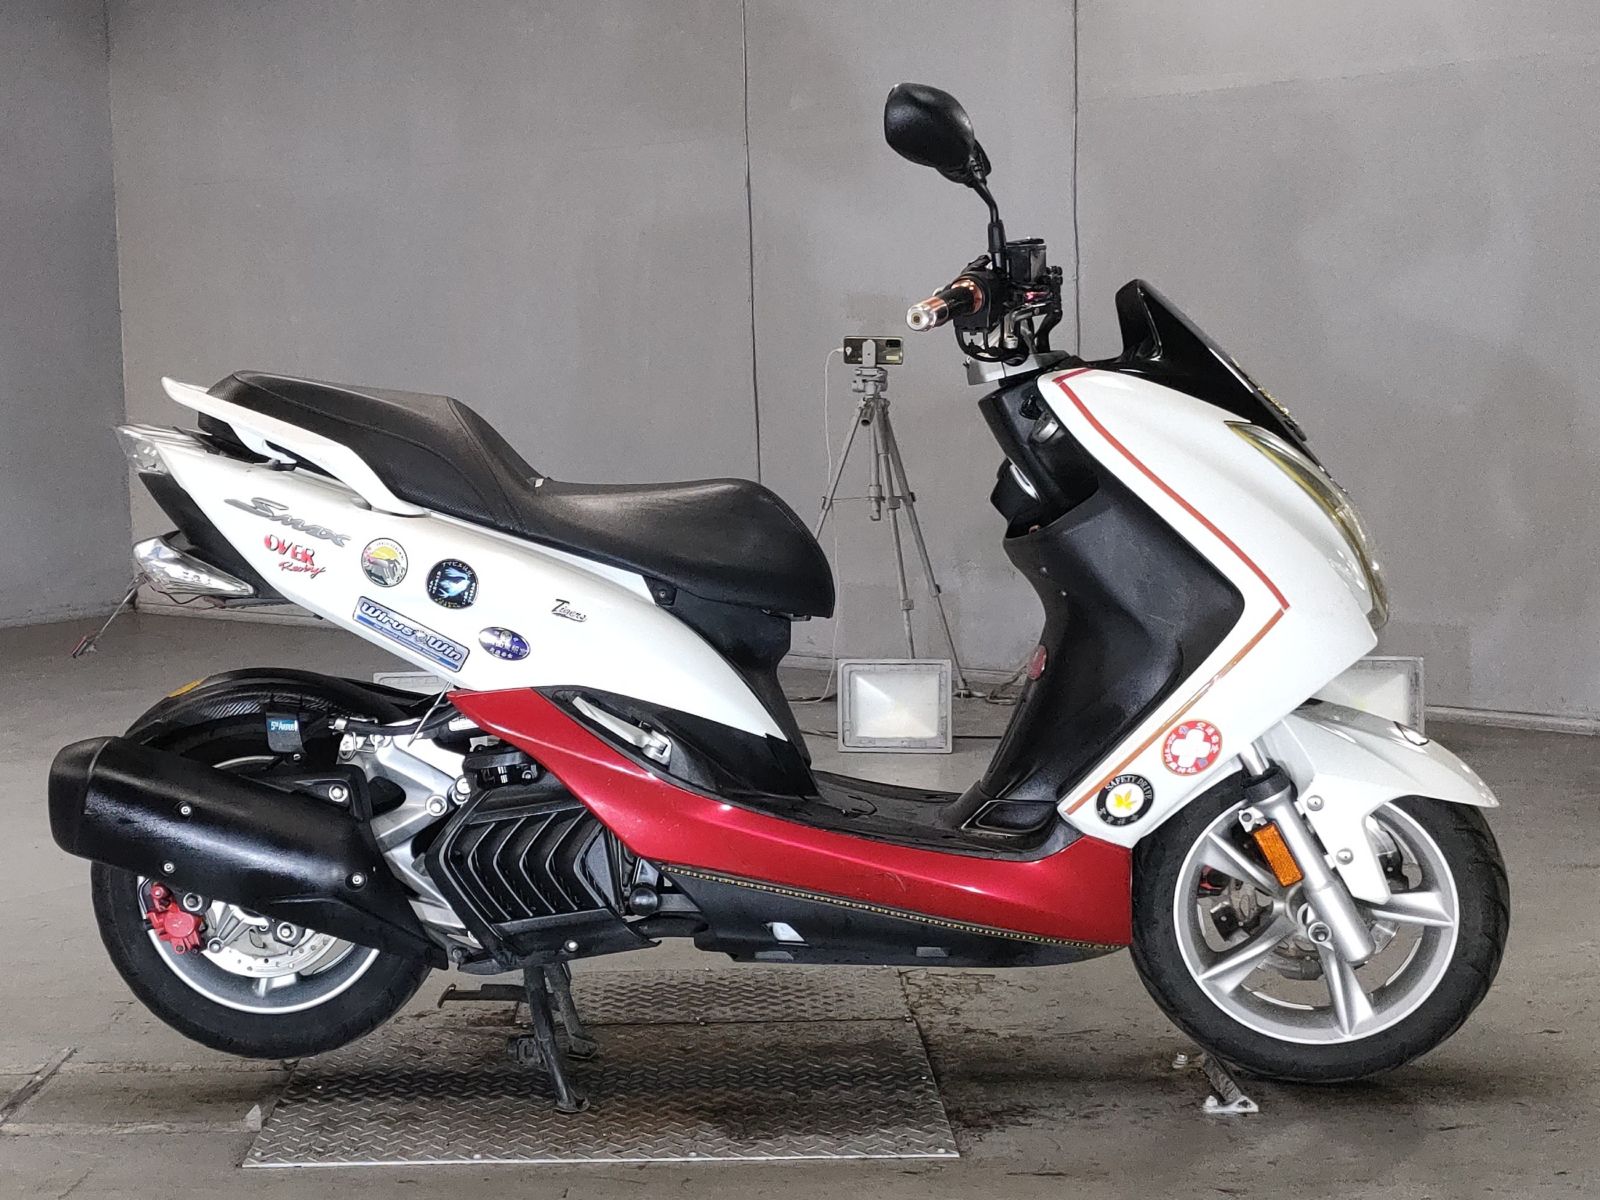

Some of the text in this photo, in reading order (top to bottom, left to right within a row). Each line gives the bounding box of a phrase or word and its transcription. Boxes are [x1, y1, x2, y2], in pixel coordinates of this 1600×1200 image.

[264, 534, 316, 566] OVER
[360, 602, 417, 636] Wirus
[426, 635, 463, 661] Win
[1105, 775, 1153, 801] SAFETY DRIVE
